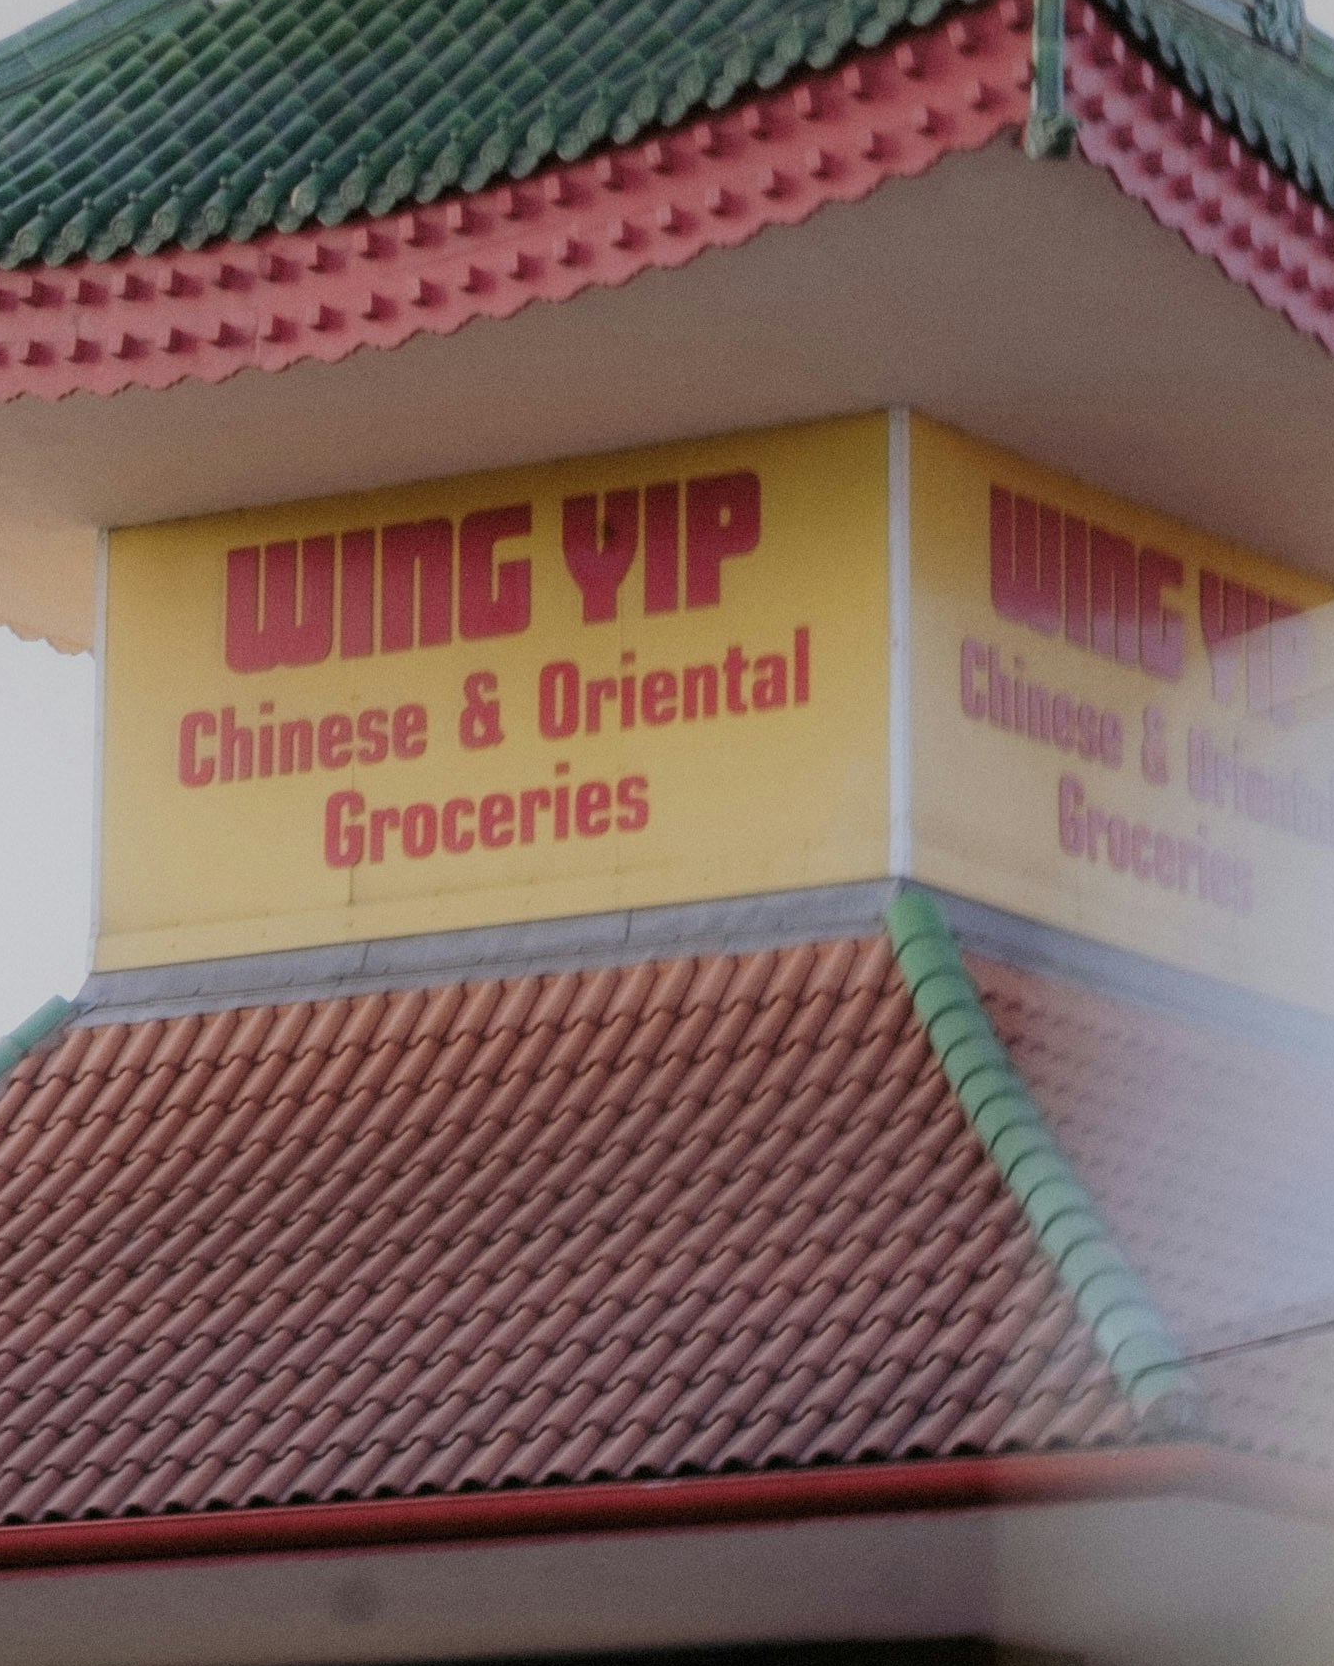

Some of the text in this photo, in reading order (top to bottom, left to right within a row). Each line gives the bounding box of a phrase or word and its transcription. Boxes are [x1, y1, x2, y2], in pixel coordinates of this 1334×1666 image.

[224, 470, 763, 673] WING YIP
[177, 626, 811, 788] Chinese & Oriental
[961, 636, 1124, 769] Chinese
[1140, 703, 1170, 787] &
[324, 763, 650, 870] Groceries
[1058, 773, 1255, 913] Groceries
